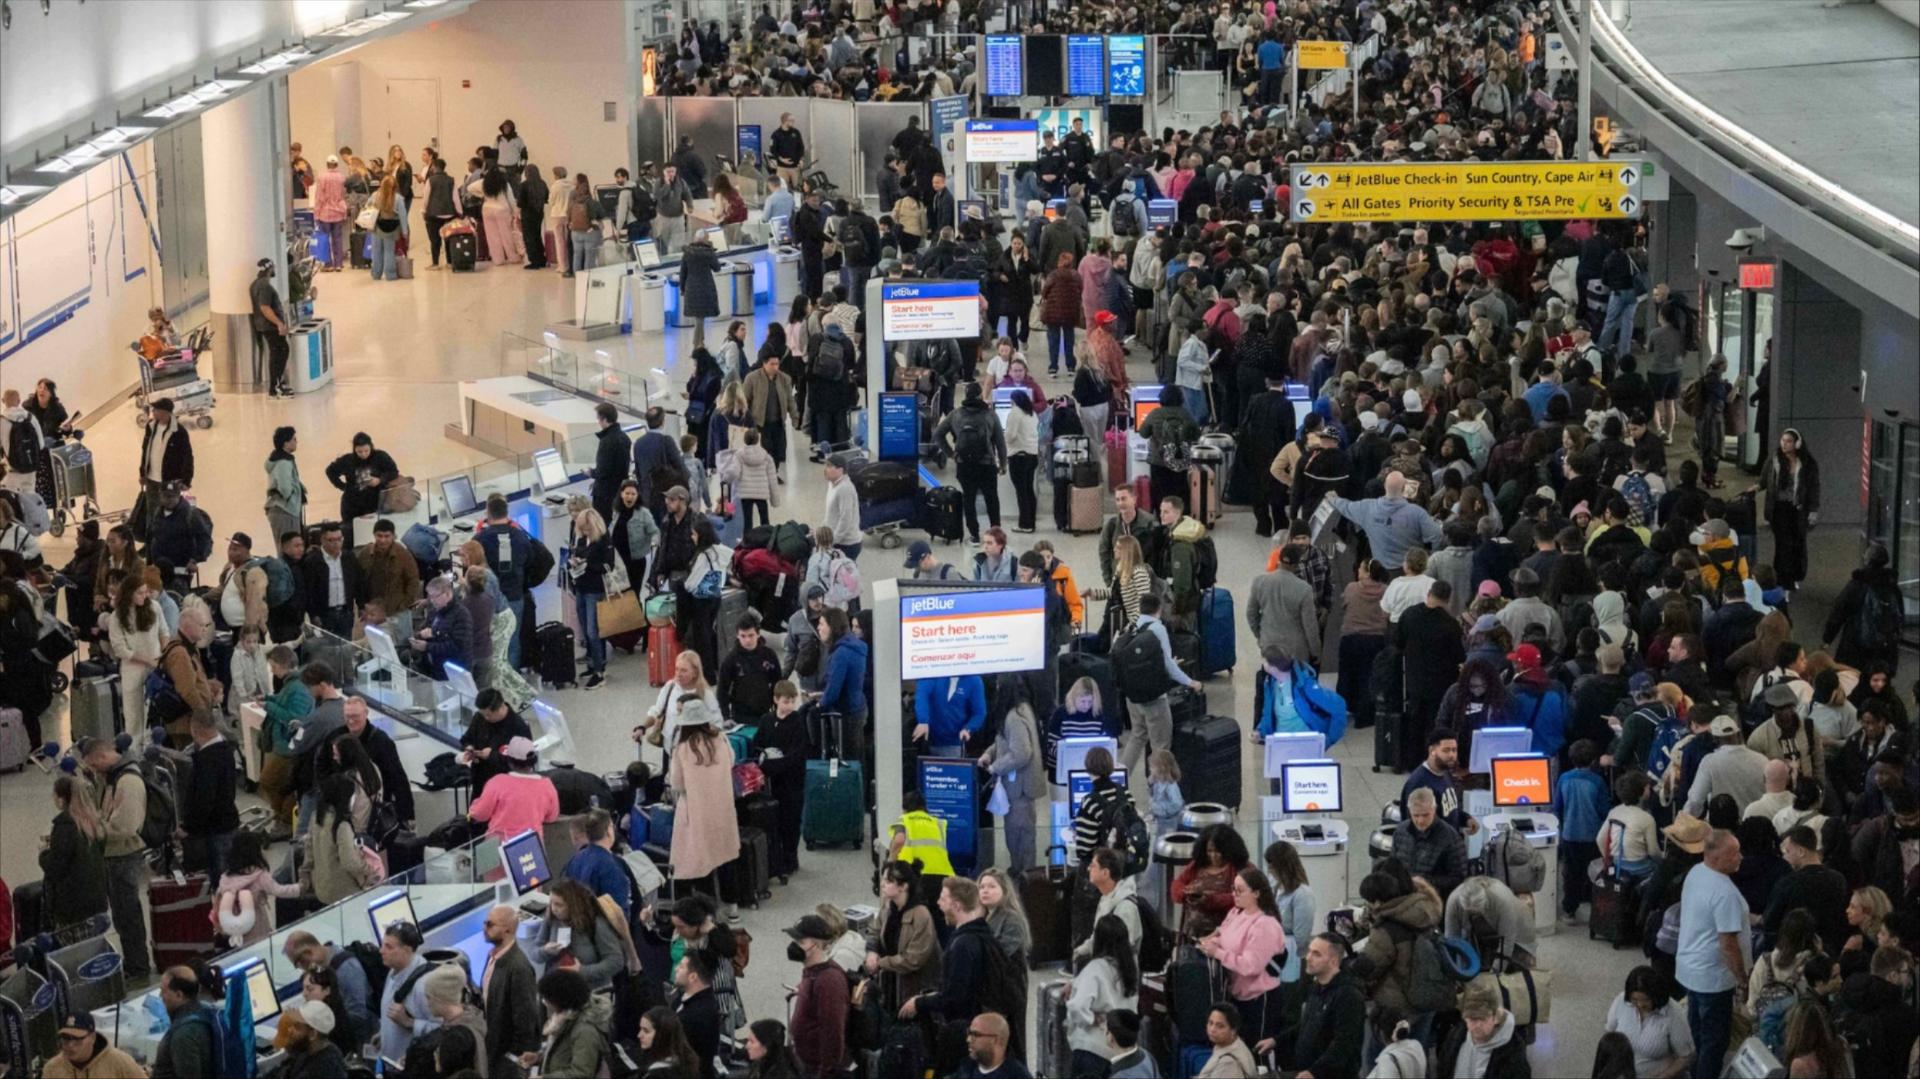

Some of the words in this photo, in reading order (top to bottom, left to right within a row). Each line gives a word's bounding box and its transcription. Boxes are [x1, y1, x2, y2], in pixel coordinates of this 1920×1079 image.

[1355, 173, 1400, 186] JetBlue
[1404, 172, 1458, 185] Check-in
[1466, 172, 1488, 184] Sun
[1491, 172, 1542, 186] Country,
[1544, 171, 1574, 185] Cape
[1577, 171, 1595, 182] Air
[1341, 198, 1360, 209] All
[1363, 198, 1401, 209] Gates
[1408, 197, 1456, 211] Priority
[1458, 195, 1510, 210] Security
[1513, 195, 1522, 207] &
[1526, 195, 1551, 207] TSA
[1554, 195, 1575, 206] Pre
[890, 287, 919, 299] jetBlue
[891, 305, 913, 313] Start
[914, 304, 933, 312] here
[911, 597, 955, 614] jetBlue
[912, 625, 945, 638] Start
[947, 624, 976, 635] here
[910, 653, 956, 663] Comenzar
[1294, 781, 1311, 789] Start
[1503, 778, 1531, 787] Check
